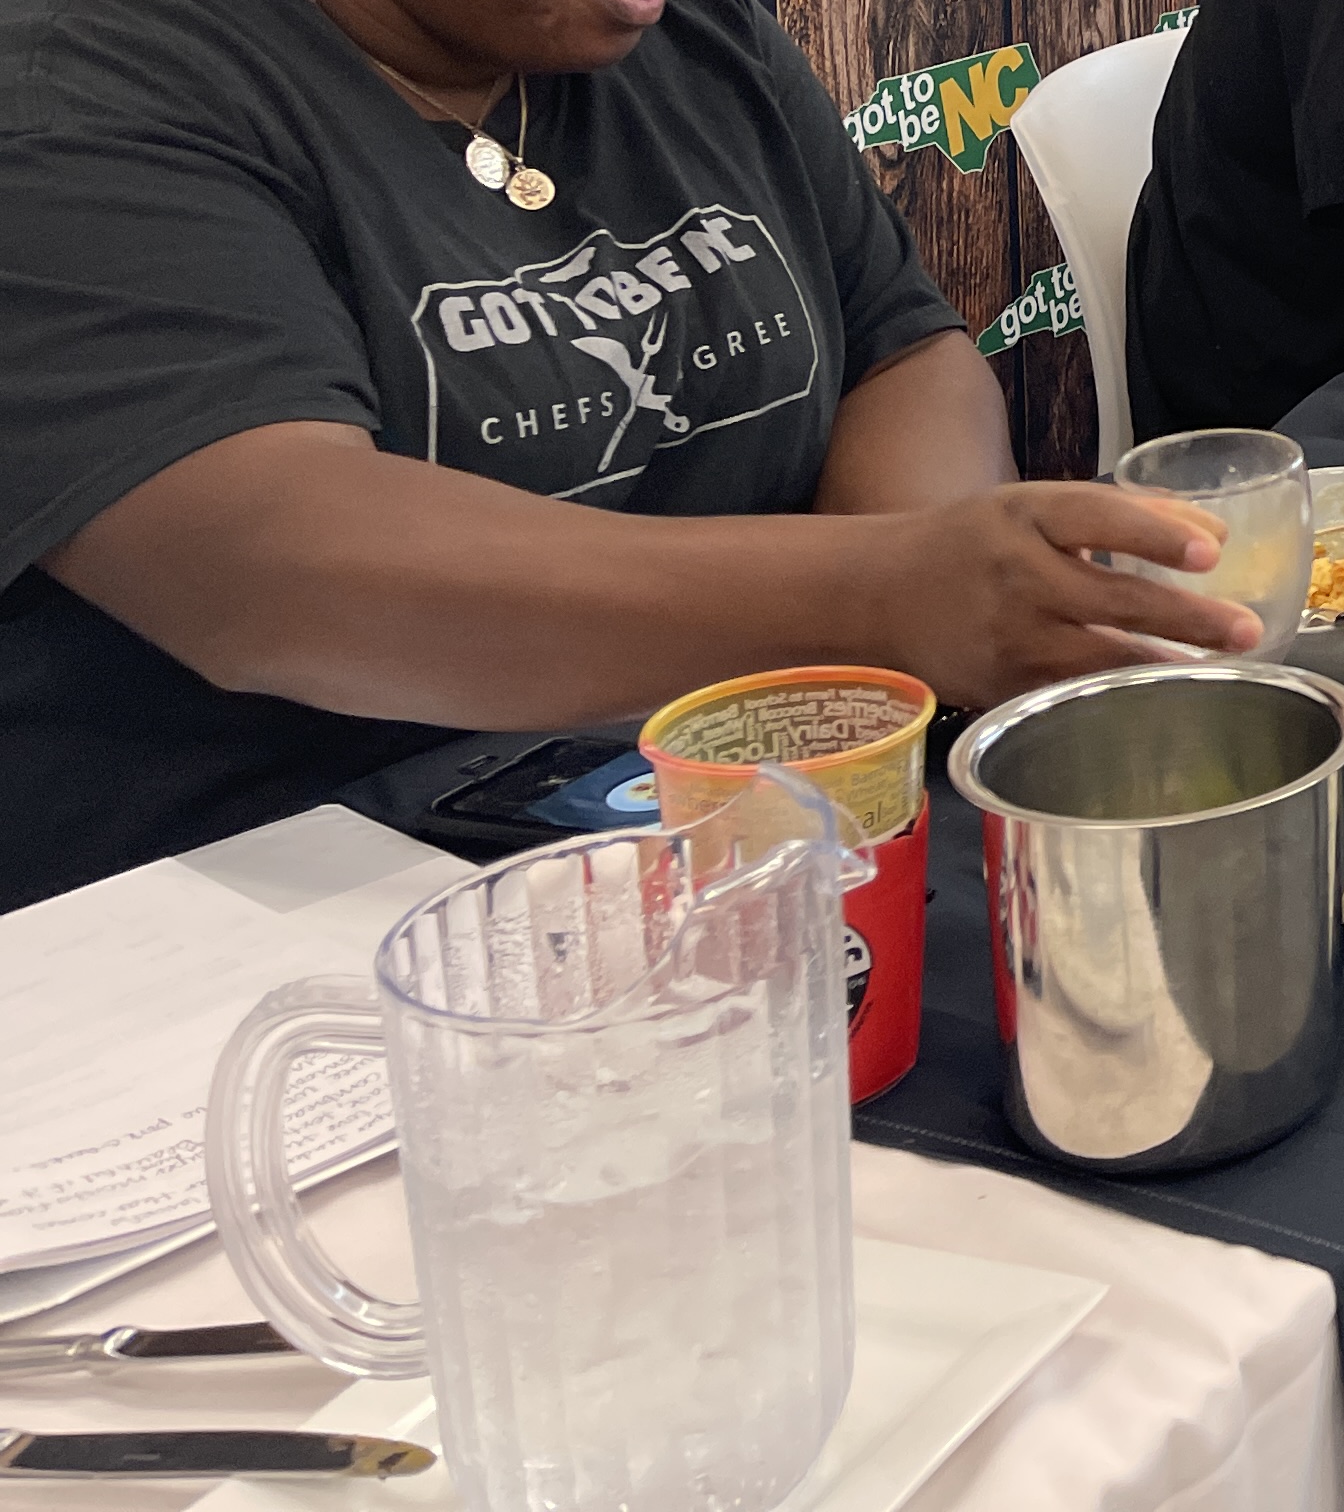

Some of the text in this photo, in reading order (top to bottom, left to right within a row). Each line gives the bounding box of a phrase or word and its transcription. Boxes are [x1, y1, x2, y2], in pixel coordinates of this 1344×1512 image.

[845, 73, 934, 152] got to
[898, 45, 1029, 157] be NC
[438, 287, 558, 352] GOT
[1000, 281, 1048, 345] got
[1049, 292, 1085, 333] be
[480, 312, 792, 445] CHEFS GREE
